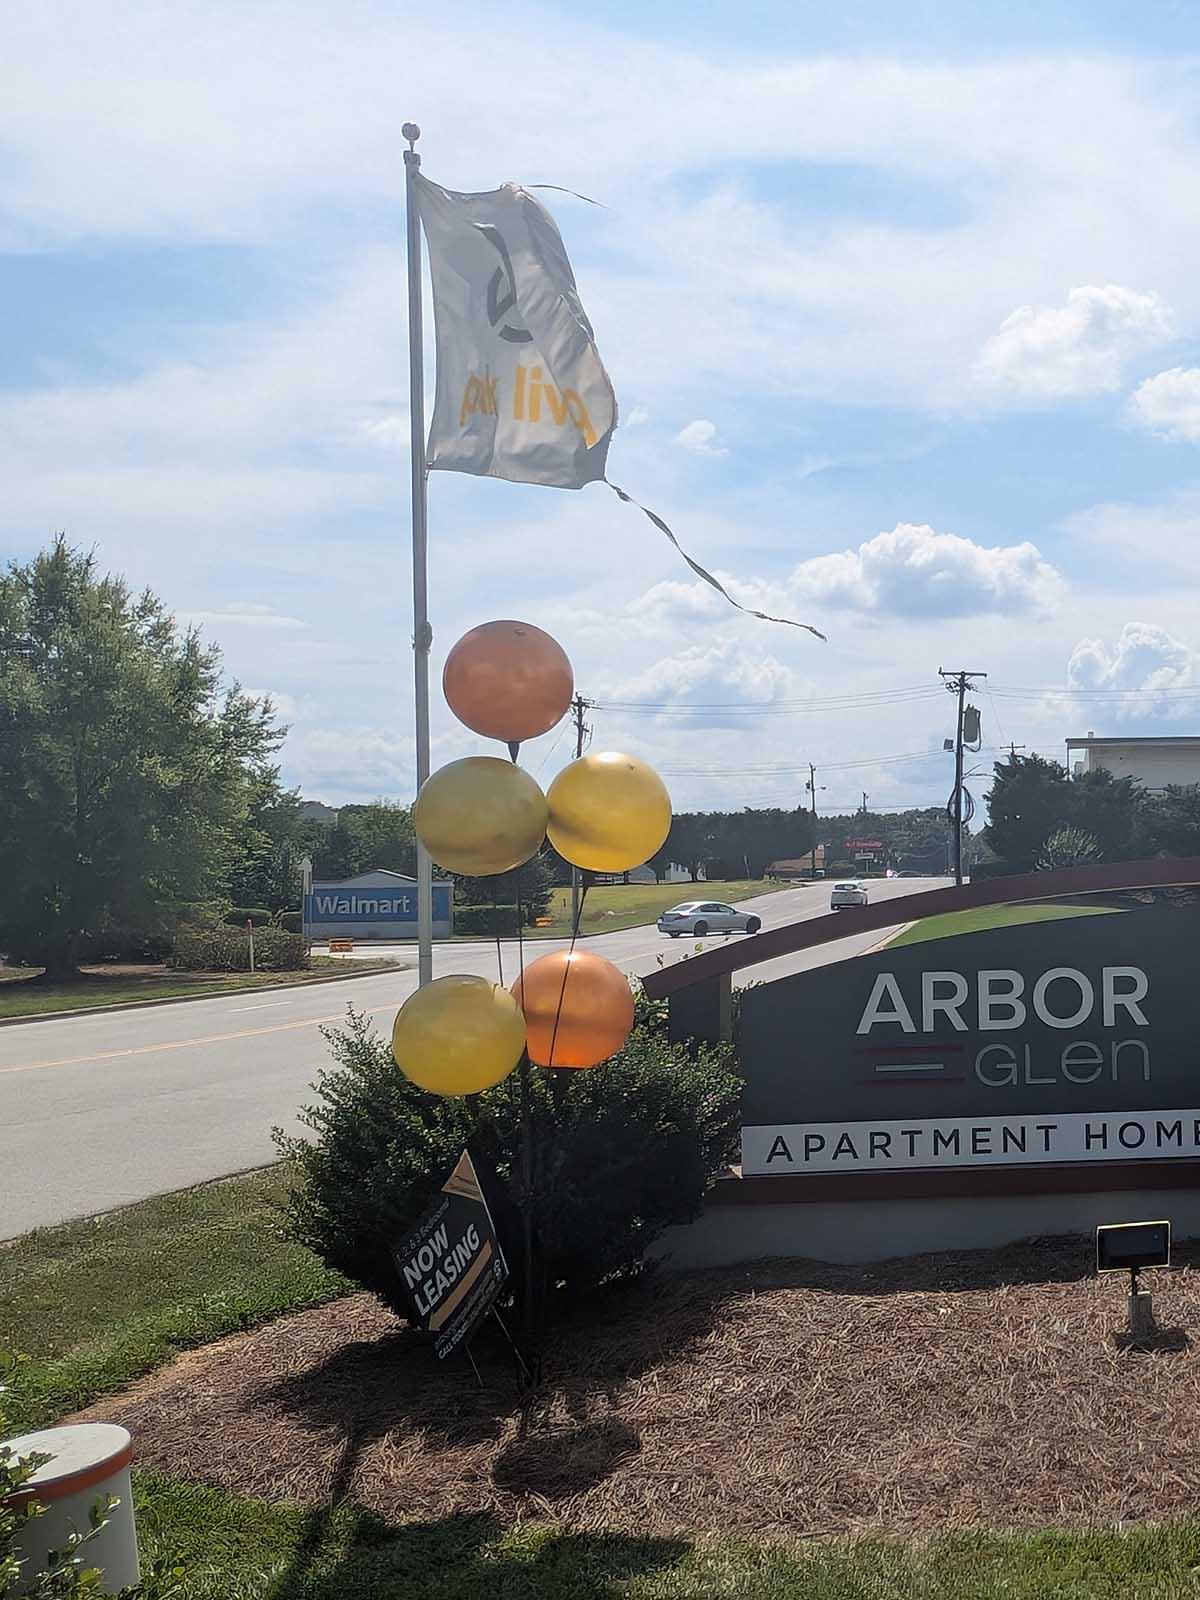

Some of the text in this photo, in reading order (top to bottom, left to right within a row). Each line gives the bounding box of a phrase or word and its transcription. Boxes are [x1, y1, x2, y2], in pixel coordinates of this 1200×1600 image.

[316, 895, 410, 915] Walmart
[856, 965, 1150, 1035] ARBOR
[765, 1124, 1059, 1164] APARTMENT
[402, 1223, 449, 1289] NOW
[413, 1223, 480, 1317] LEASING
